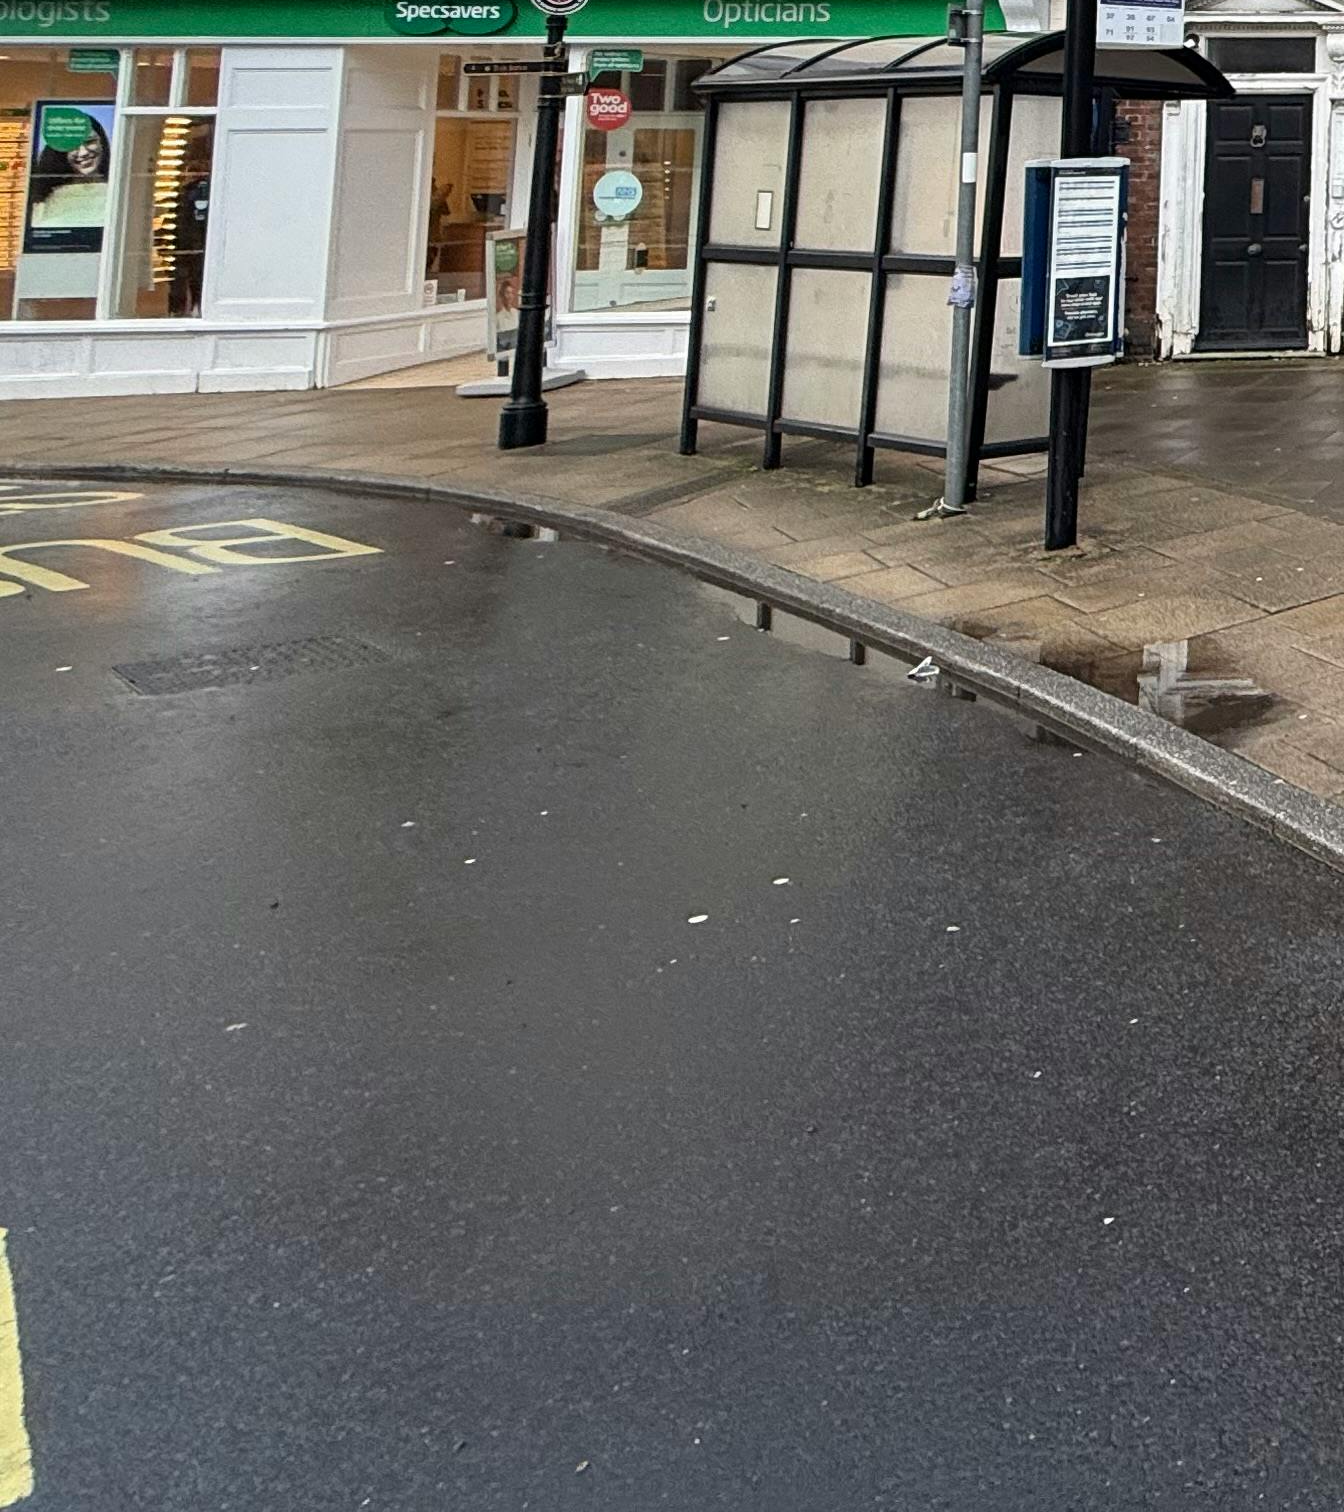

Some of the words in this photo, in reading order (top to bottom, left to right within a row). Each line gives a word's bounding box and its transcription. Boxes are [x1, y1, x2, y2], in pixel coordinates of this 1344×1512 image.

[395, 1, 501, 23] Specsavers
[591, 92, 621, 104] Two
[590, 101, 628, 116] good
[0, 519, 385, 598] BU
